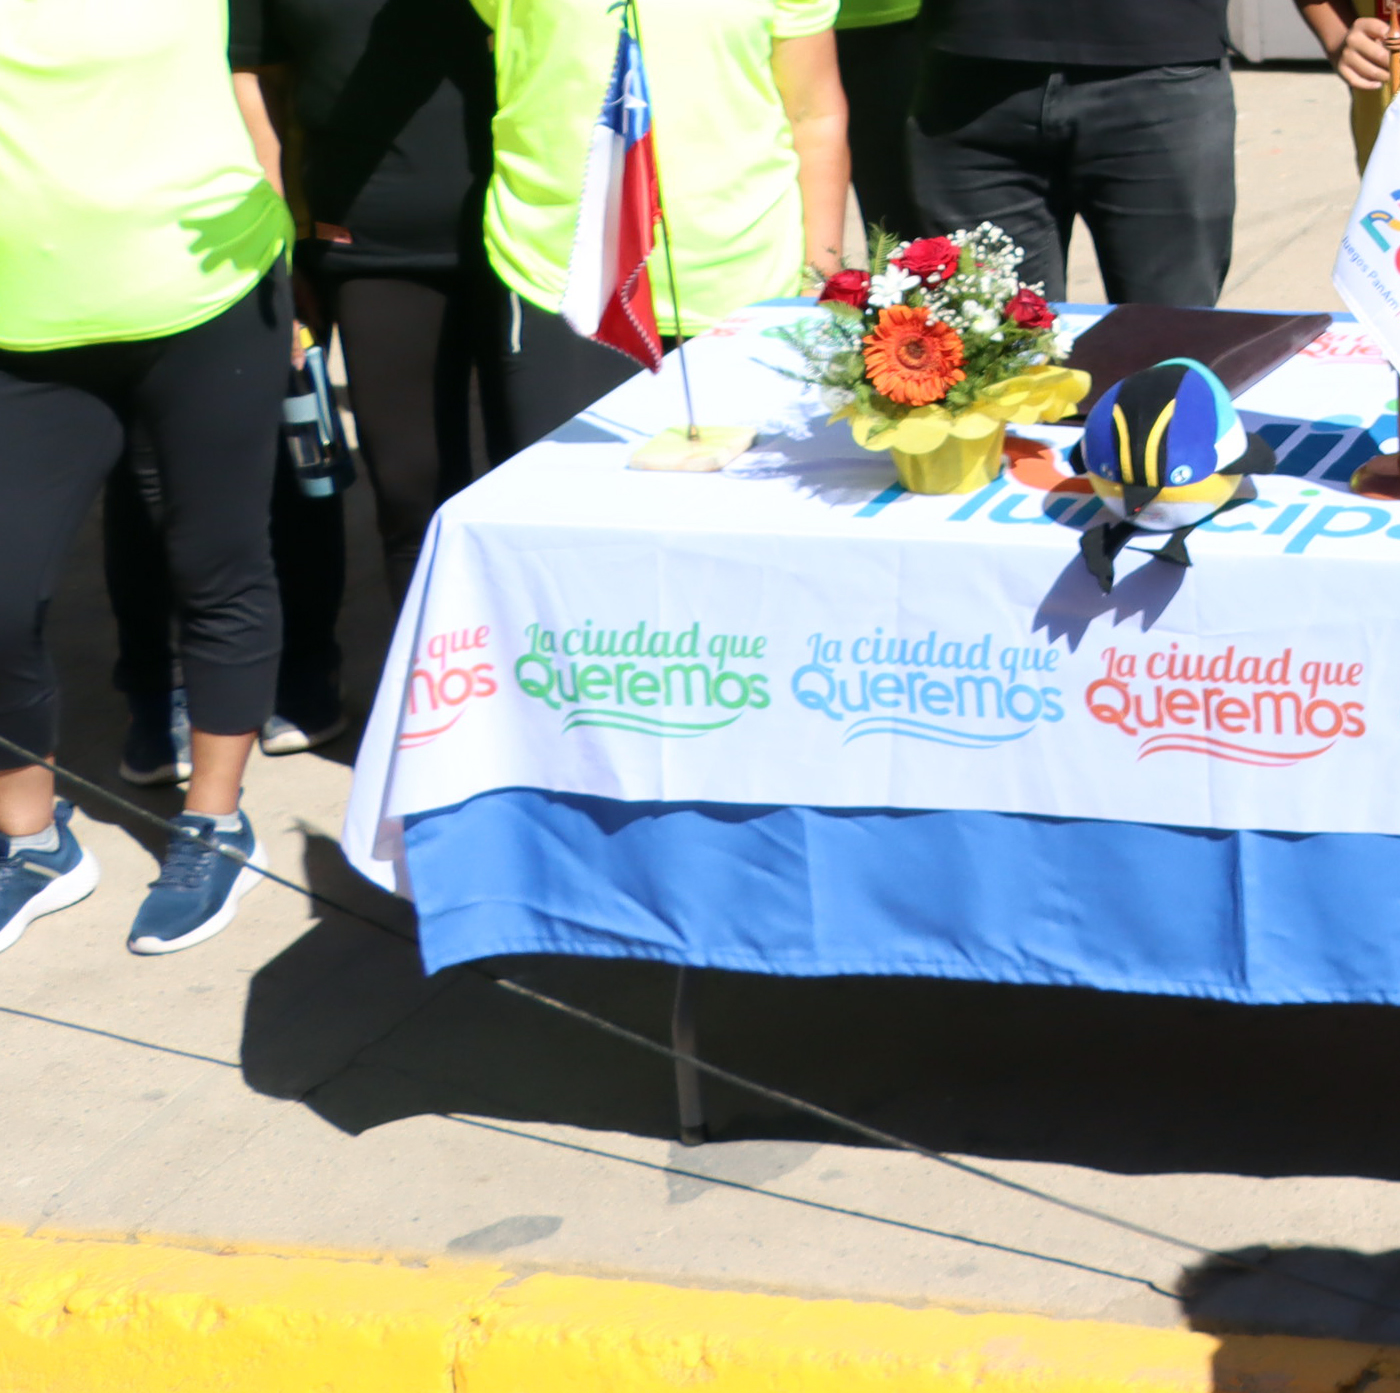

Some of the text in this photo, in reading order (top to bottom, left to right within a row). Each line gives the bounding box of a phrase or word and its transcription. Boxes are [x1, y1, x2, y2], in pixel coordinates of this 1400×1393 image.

[427, 624, 490, 670] que
[524, 619, 767, 670] La ciudad que
[806, 627, 1060, 682] La ciudad que
[1101, 642, 1363, 700] La ciudad que
[514, 653, 771, 710] Queremos
[791, 664, 1065, 723] Queremos
[1085, 678, 1366, 739] Queremos
